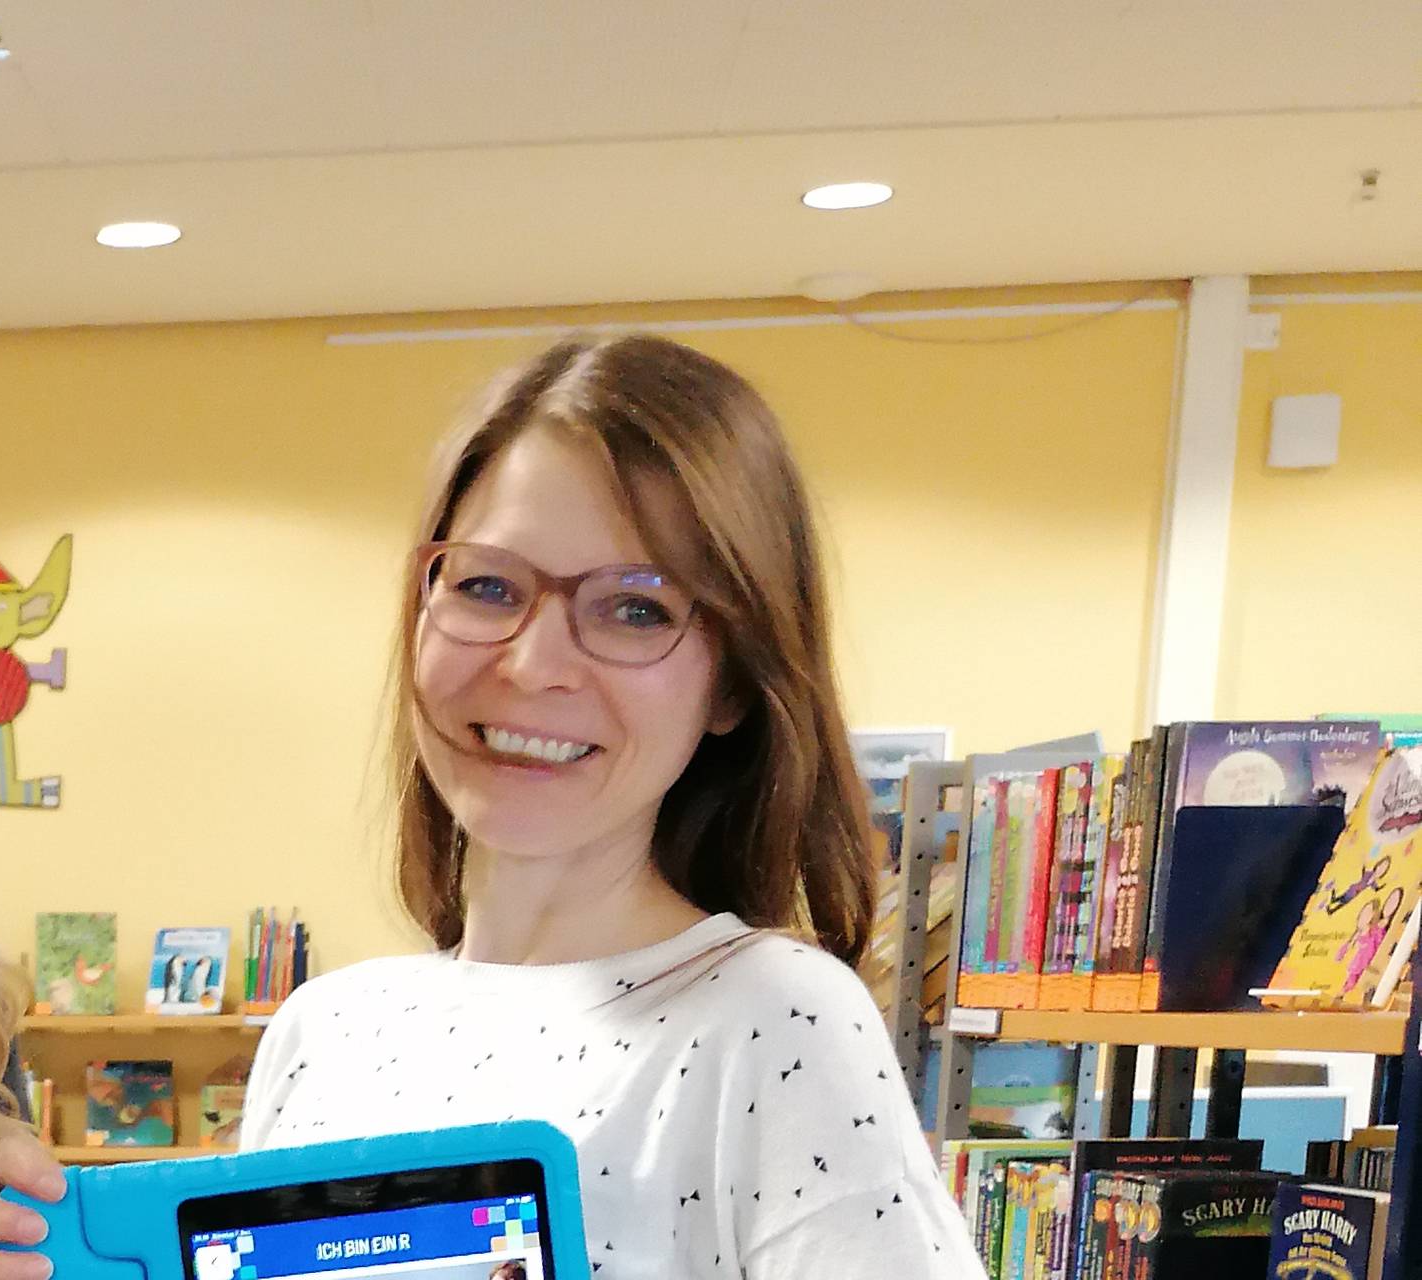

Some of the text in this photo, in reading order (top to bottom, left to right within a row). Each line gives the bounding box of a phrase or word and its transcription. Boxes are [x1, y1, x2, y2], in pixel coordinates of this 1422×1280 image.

[1182, 1197, 1247, 1227] SCARY
[1283, 1209, 1320, 1236] SCARY
[1320, 1210, 1358, 1246] HARRY
[316, 1233, 411, 1261] ICH BIN EIN R
